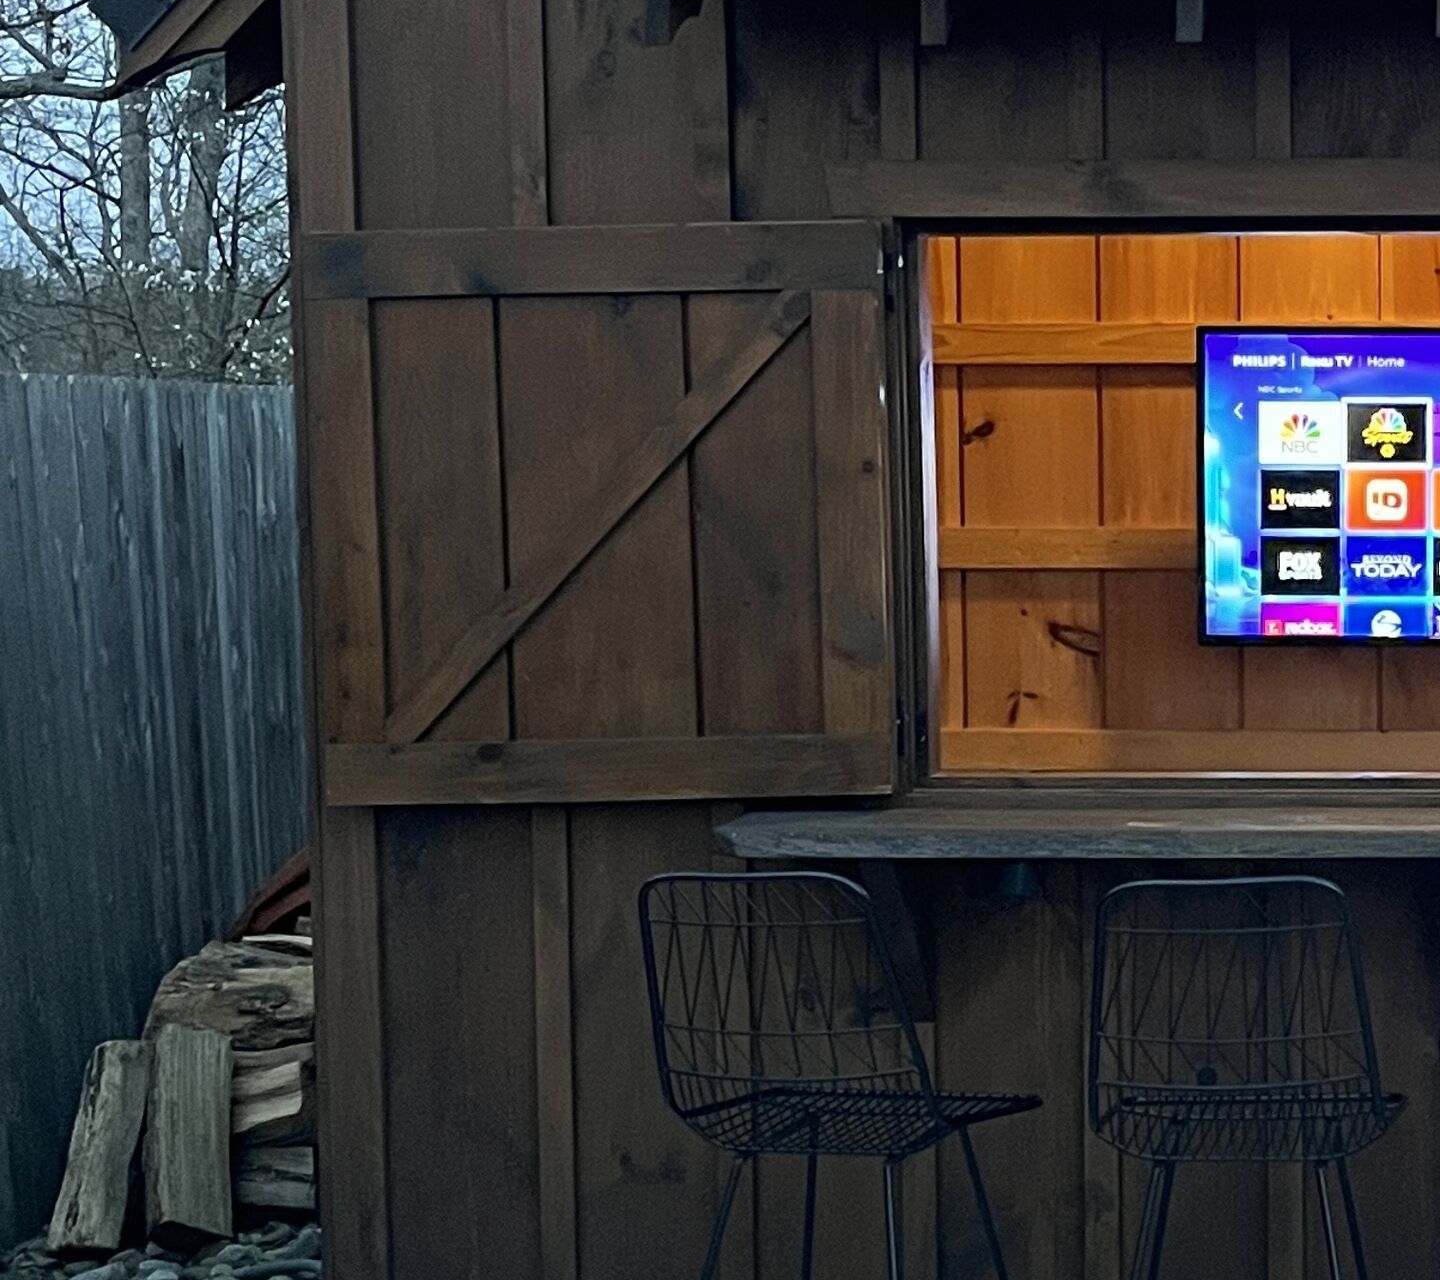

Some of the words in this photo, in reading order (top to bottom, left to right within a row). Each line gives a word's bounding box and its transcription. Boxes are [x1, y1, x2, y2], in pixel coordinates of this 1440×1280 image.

[1233, 355, 1286, 368] PHILIPS
[1300, 355, 1334, 368] Roku
[1335, 355, 1353, 368] TV
[1367, 356, 1405, 368] Home
[1281, 440, 1319, 453] NBC
[1372, 492, 1402, 508] ID
[1279, 551, 1322, 573] FOX
[1351, 563, 1422, 578] TODAY
